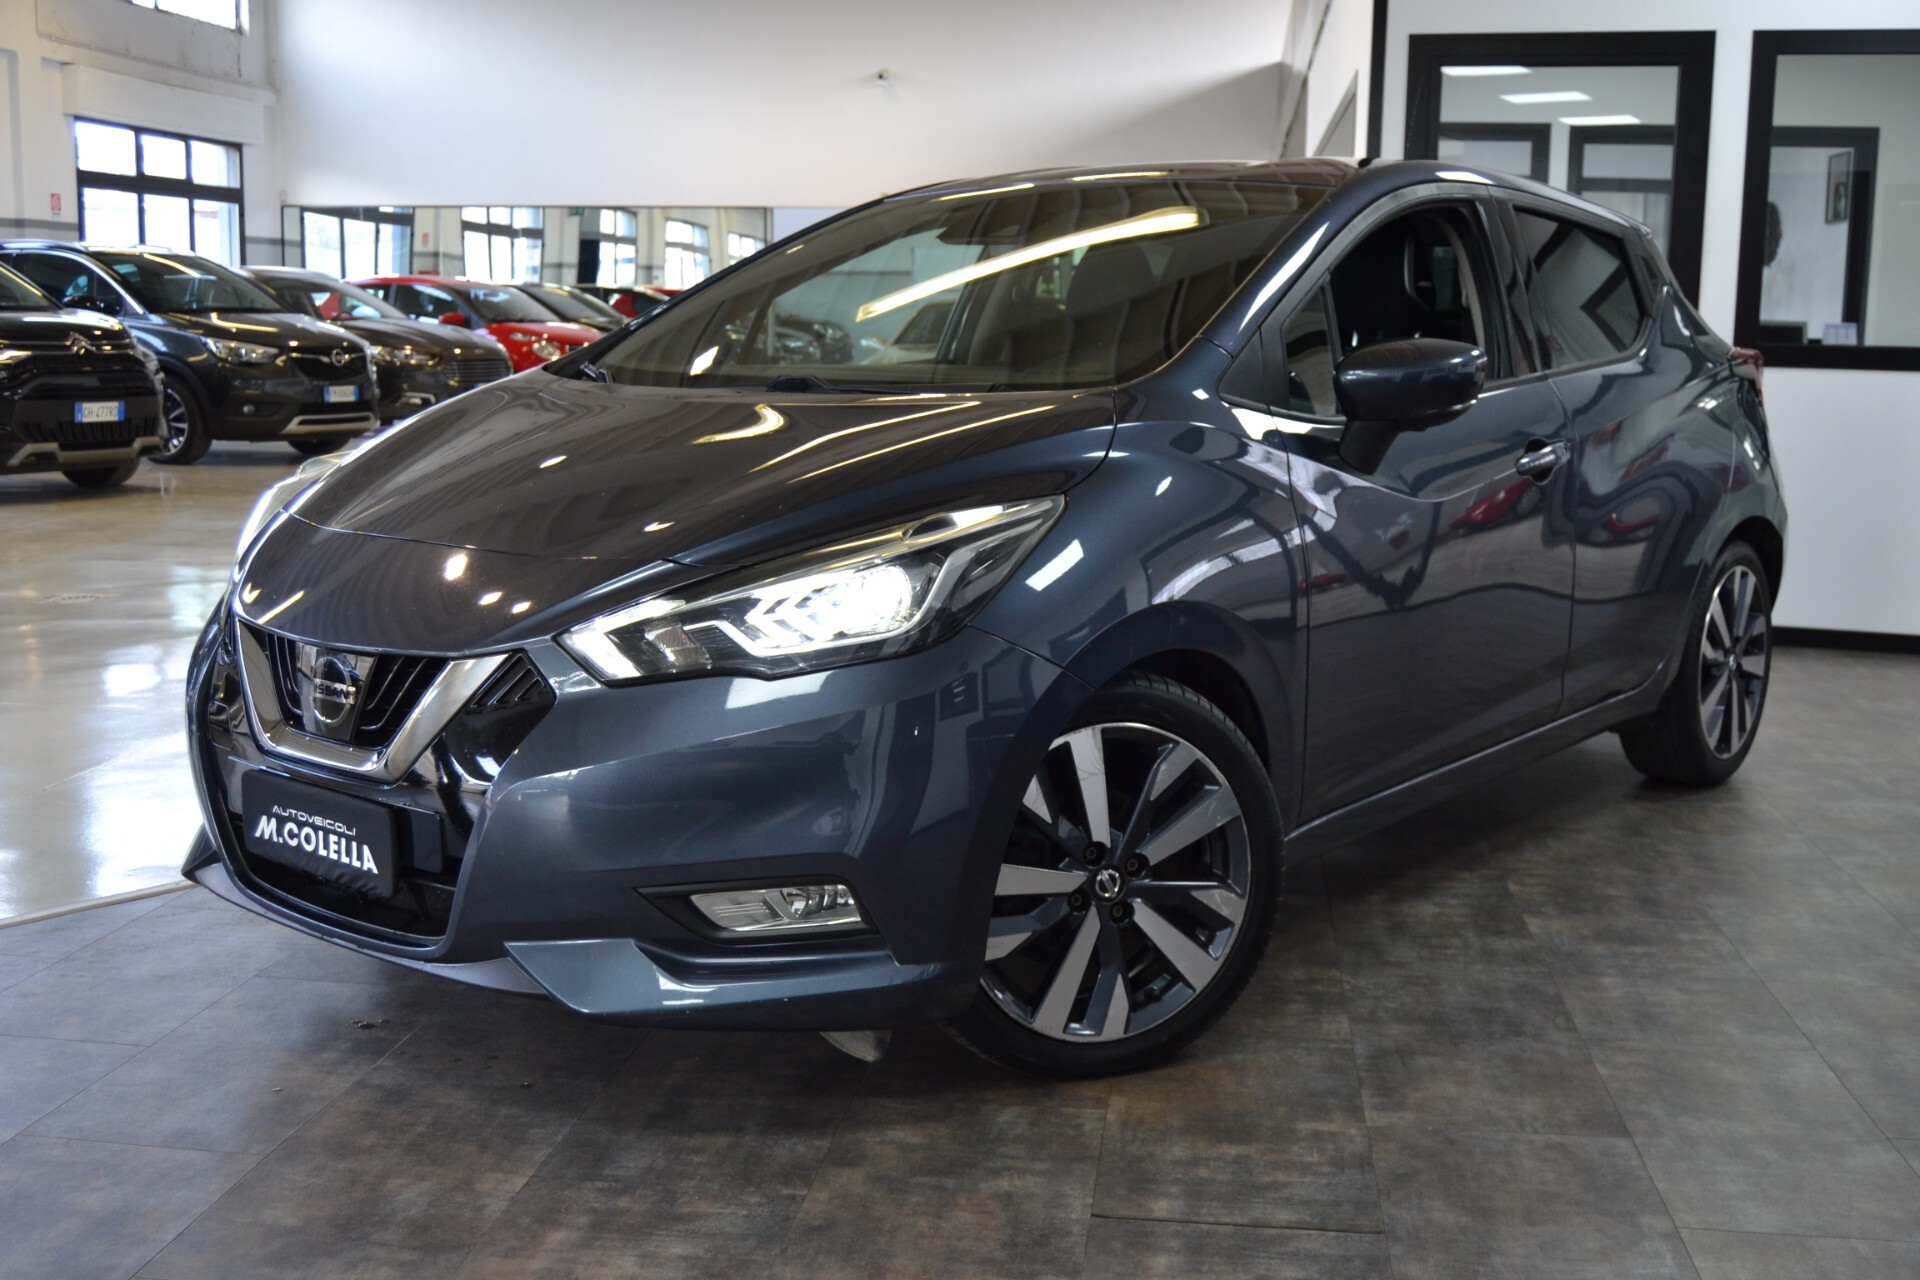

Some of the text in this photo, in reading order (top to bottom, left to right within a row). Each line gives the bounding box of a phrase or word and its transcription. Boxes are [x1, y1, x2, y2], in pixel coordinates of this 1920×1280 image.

[313, 682, 350, 700] ISSAN
[272, 804, 356, 836] AUTOVEICOLI
[254, 814, 379, 875] M.COLELLA
